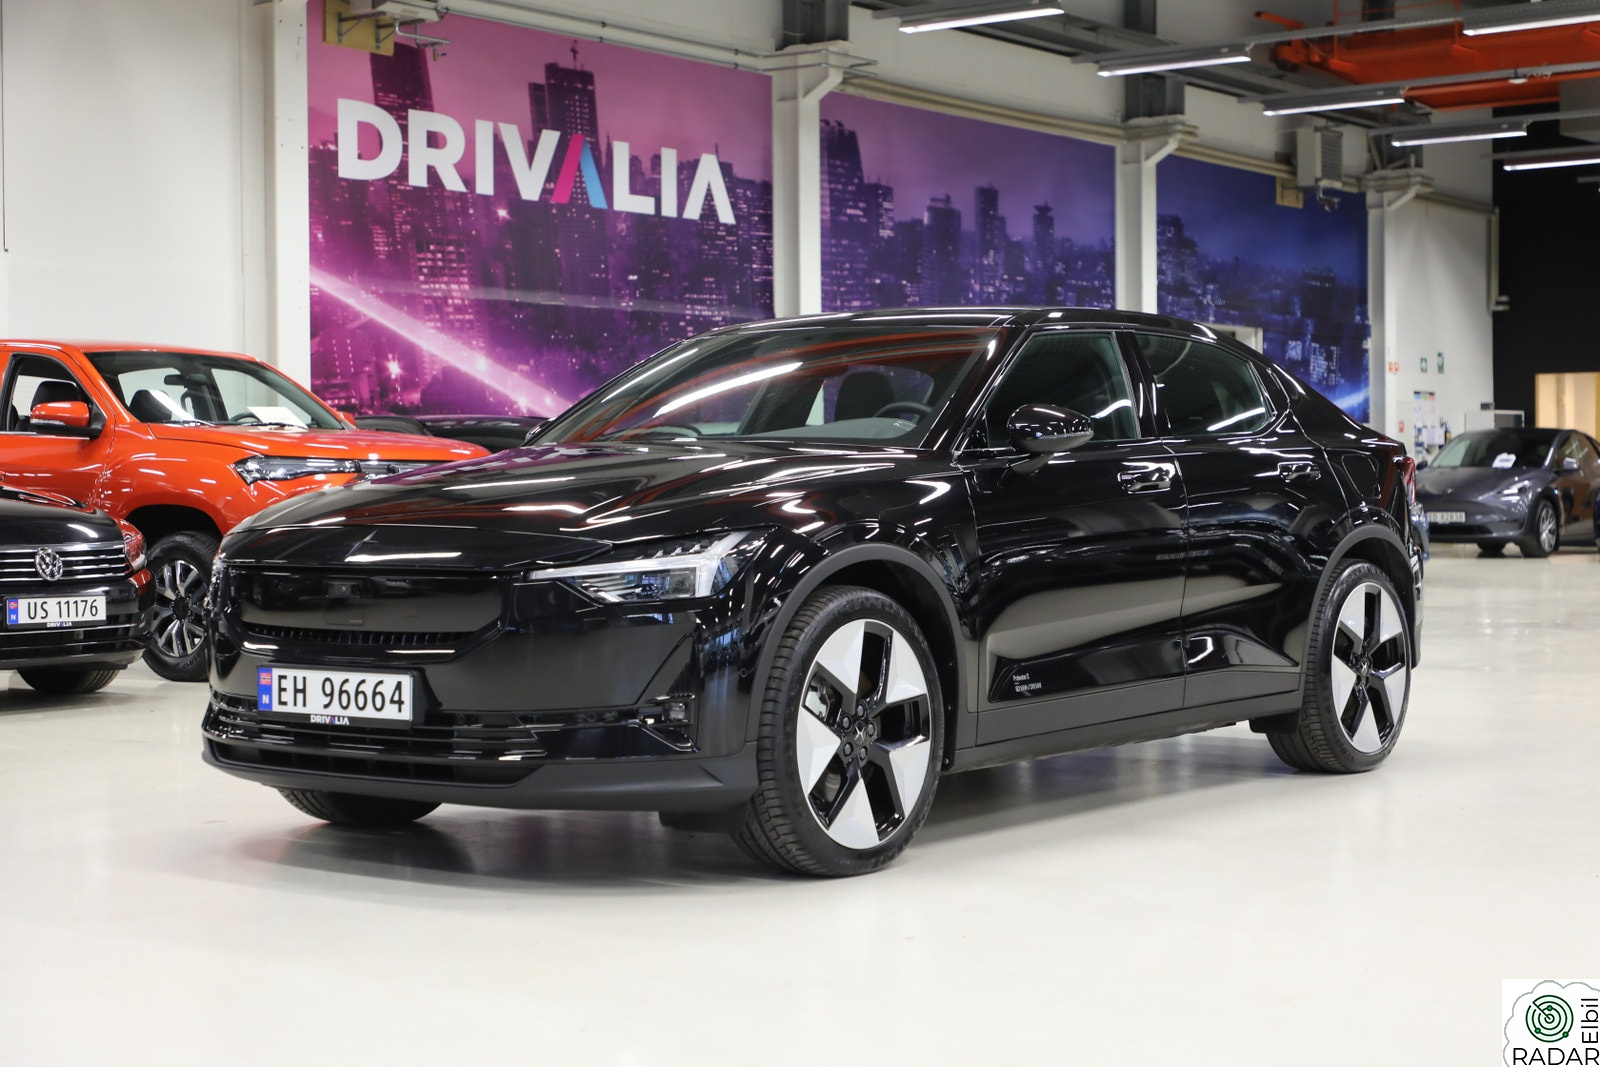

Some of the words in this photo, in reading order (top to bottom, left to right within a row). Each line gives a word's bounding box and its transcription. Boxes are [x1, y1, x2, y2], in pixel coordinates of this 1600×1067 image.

[337, 98, 736, 224] DRIVALIA
[27, 601, 49, 620] US
[56, 599, 98, 619] 11176
[262, 694, 269, 704] N
[277, 674, 307, 707] EH
[321, 676, 405, 713] 96664
[310, 714, 350, 726] DRIVALIA
